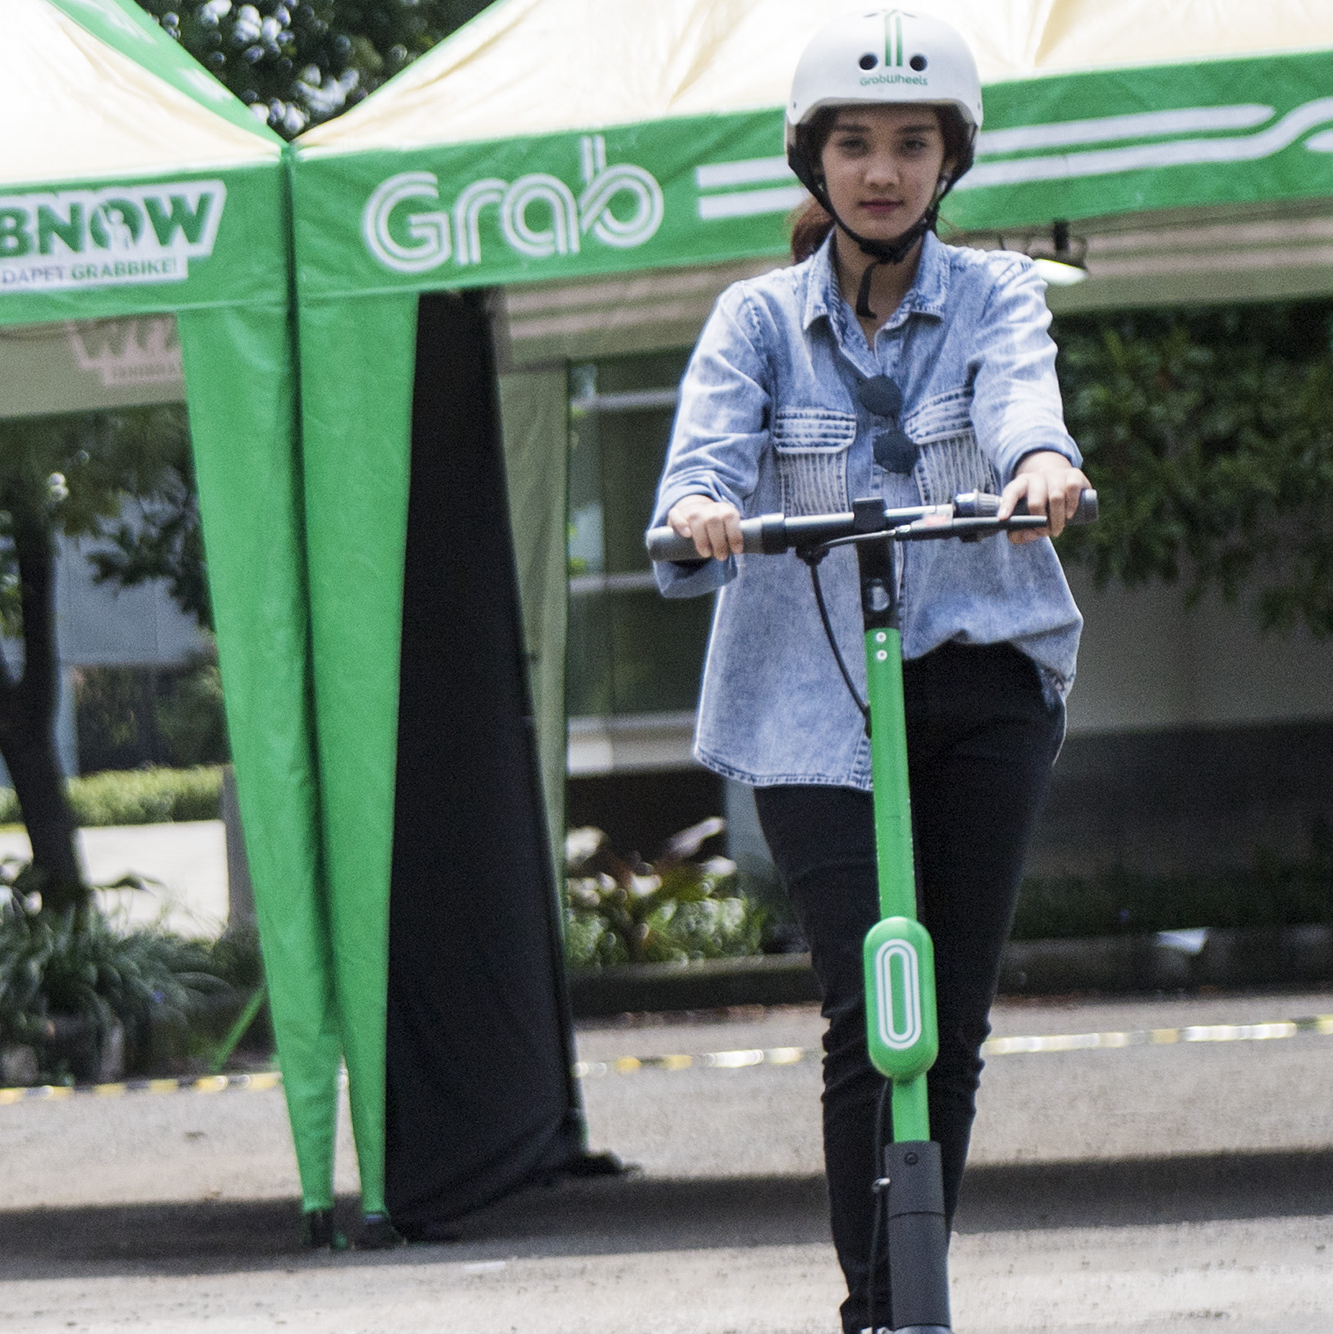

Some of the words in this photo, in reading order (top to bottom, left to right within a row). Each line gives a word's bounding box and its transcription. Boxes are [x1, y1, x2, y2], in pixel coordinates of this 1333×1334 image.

[859, 74, 929, 87] GrabWheels
[363, 134, 665, 273] Grab
[2, 264, 68, 286] DAPET
